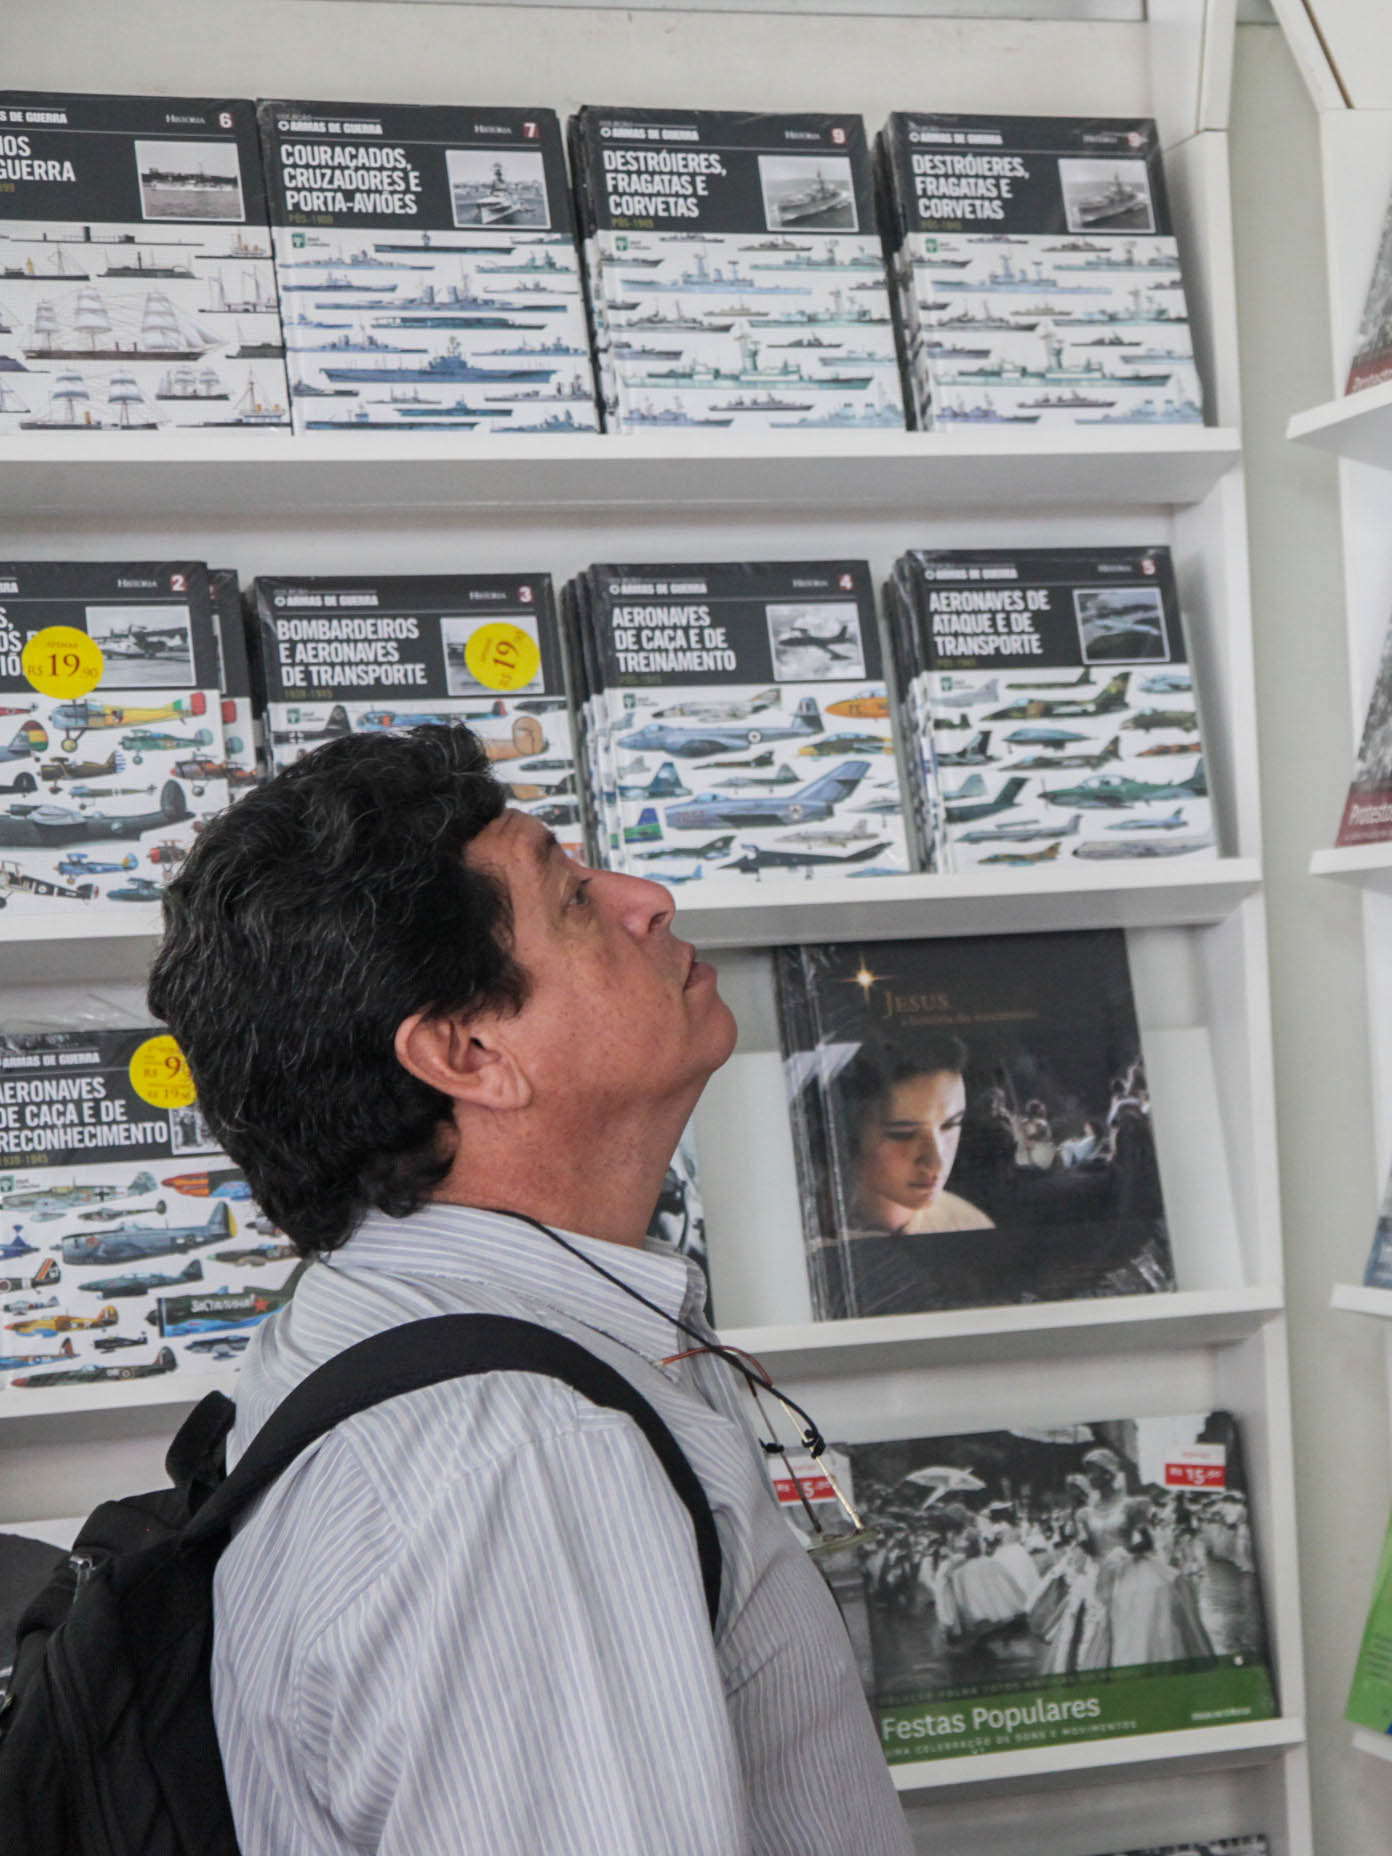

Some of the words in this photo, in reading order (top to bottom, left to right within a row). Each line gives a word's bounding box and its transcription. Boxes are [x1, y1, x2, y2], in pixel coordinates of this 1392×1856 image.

[25, 112, 68, 124] GUERRA
[219, 112, 233, 128] 6
[524, 122, 537, 138] 7
[280, 144, 412, 171] COURAÇADOS,
[603, 148, 727, 177] DESTRÓIERES,
[912, 154, 1030, 180] DESTRÓIERES,
[283, 168, 405, 191] CRUZADORES
[408, 171, 422, 192] E
[606, 173, 693, 195] FRAGATAS
[696, 176, 709, 196] E
[915, 177, 997, 198] FRAGATAS
[1000, 179, 1013, 198] E
[286, 189, 417, 215] PORTA-AVIÕES
[608, 194, 700, 218] CORVETAS
[918, 198, 1004, 220] CORVETAS
[171, 574, 186, 591] 2
[519, 586, 533, 602] 3
[929, 591, 1025, 613] AERONAVES
[1027, 589, 1051, 611] DE
[612, 605, 711, 628] AERONAVES
[932, 611, 995, 635] ATAQUE
[996, 612, 1009, 633] E
[1011, 611, 1035, 633] DE
[276, 618, 420, 641] BOMBARDEIROS
[615, 629, 640, 650] DE
[641, 629, 687, 653] CAÇA
[689, 629, 702, 649] E
[704, 627, 728, 649] DE
[279, 643, 292, 663] E
[295, 641, 400, 663] AERONAVES
[933, 633, 1043, 657] TRANSPORTE
[47, 653, 81, 677] 19
[616, 649, 737, 673] TREINAMENTO
[281, 666, 305, 687] DE
[307, 664, 428, 686] TRANSPORTE
[165, 1055, 181, 1081] 9
[24, 1101, 79, 1127] CAÇA
[83, 1101, 97, 1122] E
[103, 1099, 128, 1122] DE
[0, 1120, 169, 1152] RECONHECIMENTO
[881, 1711, 966, 1743] Festas
[972, 1697, 1101, 1734] Populares
